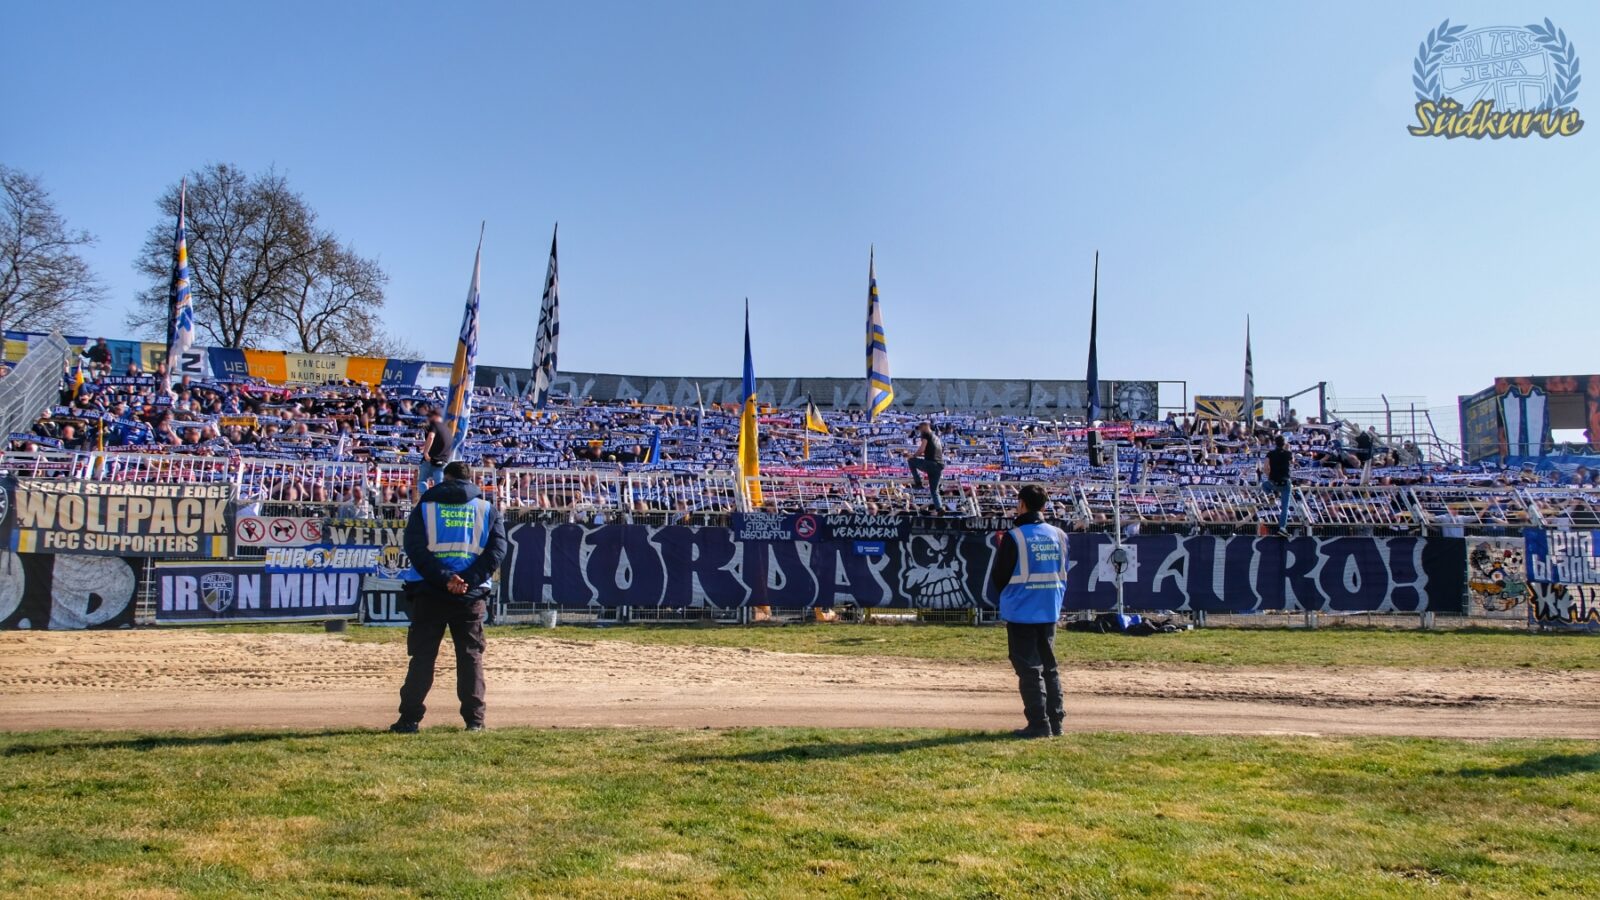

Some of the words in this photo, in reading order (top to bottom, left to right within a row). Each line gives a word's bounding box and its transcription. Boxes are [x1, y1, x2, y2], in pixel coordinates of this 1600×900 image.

[224, 360, 276, 374] WEIMAR
[494, 373, 598, 403] NFV
[832, 377, 1085, 409] VRÄNDERN
[85, 483, 180, 497] STRAIGHT
[183, 486, 229, 498] EDGE
[15, 489, 228, 534] WOLFPACK
[440, 509, 475, 519] SECURITY
[445, 518, 475, 528] SERVICE
[854, 515, 903, 527] RADIKAL
[832, 526, 899, 538] VERÄNDERN
[44, 531, 80, 550] FCC
[83, 533, 199, 553] SUPPORTERS
[1030, 543, 1060, 552] SECURITY
[1035, 552, 1060, 561] SERVICE
[508, 522, 893, 609] HORDA
[270, 573, 360, 609] MIND
